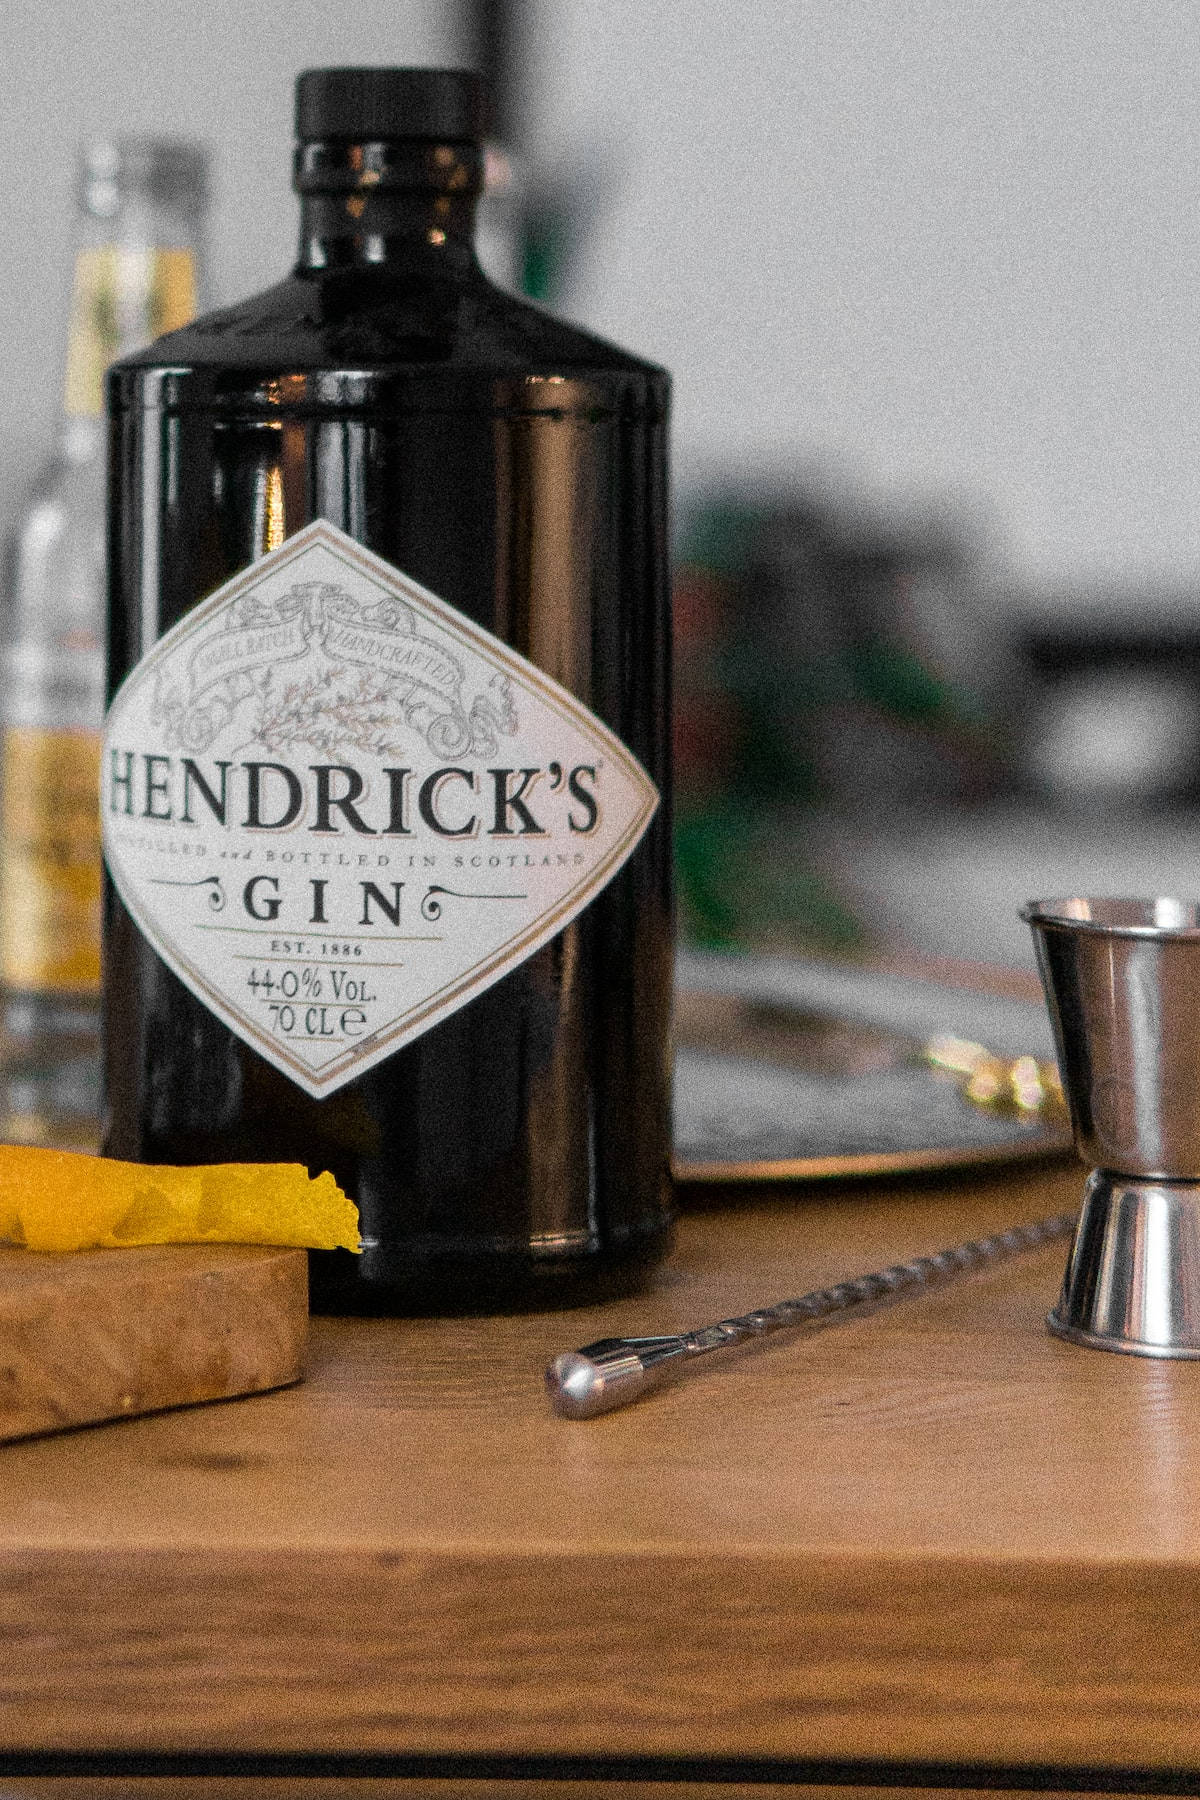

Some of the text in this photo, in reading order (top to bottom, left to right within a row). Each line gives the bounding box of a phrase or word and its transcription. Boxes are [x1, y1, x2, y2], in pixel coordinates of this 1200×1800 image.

[332, 628, 456, 686] HANDCRAFTED
[111, 749, 599, 837] HENDRICK'S
[266, 851, 390, 867] BOTTLED
[408, 854, 436, 867] IN
[454, 853, 585, 868] SCOTLAND
[242, 874, 406, 927] GIN
[270, 940, 363, 956] EST. 1886
[268, 1004, 296, 1033] 70
